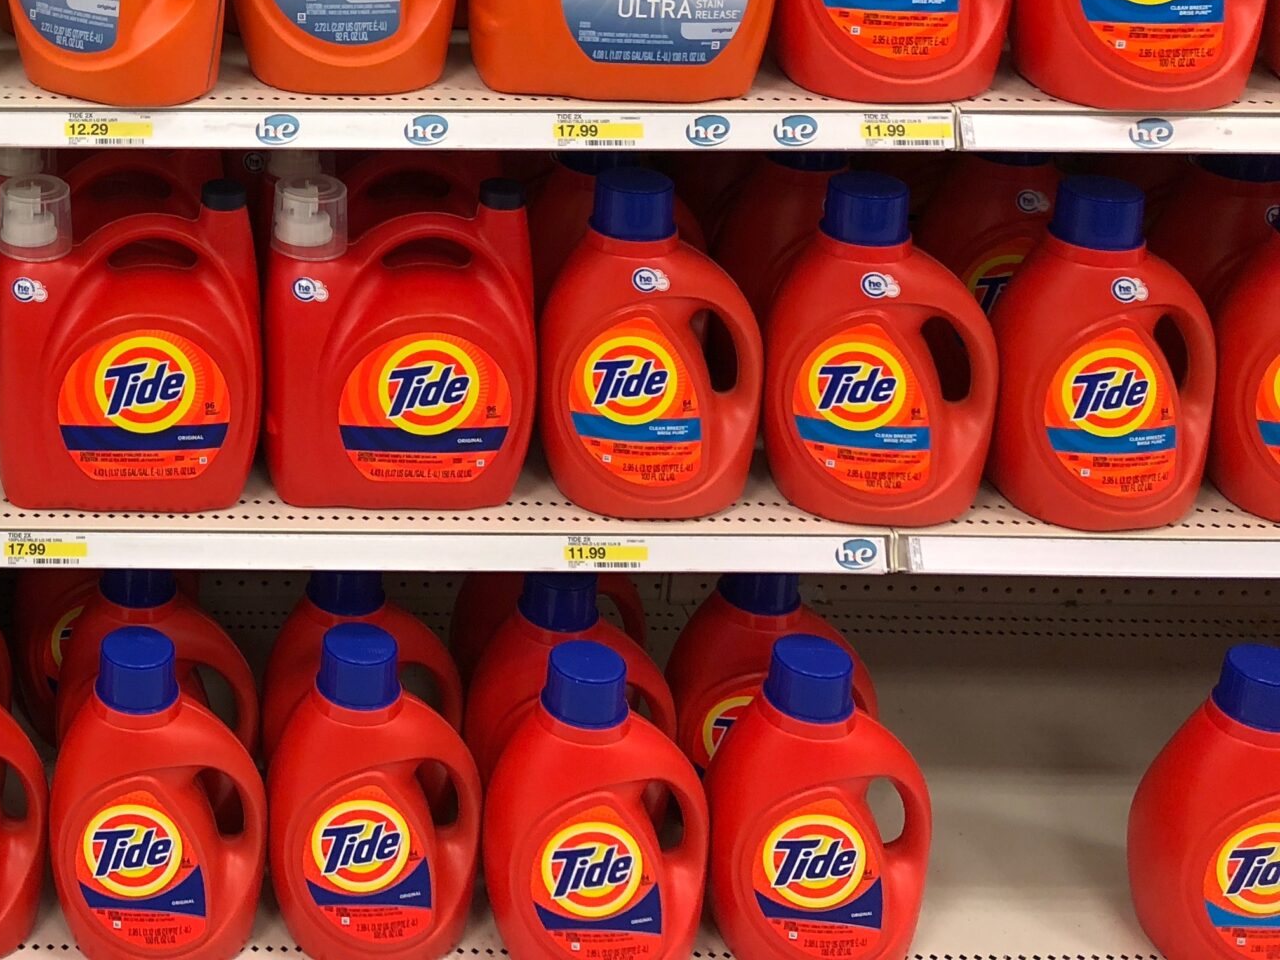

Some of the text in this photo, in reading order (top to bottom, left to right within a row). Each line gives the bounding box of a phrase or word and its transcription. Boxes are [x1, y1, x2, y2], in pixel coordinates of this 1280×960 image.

[618, 0, 691, 18] ULTRA
[696, 0, 723, 8] STAIN
[69, 124, 108, 135] 12.29
[258, 117, 298, 143] he
[406, 117, 446, 143] he
[558, 125, 597, 136] 17.99
[688, 118, 728, 144] he
[776, 117, 815, 143] he
[865, 125, 905, 136] 11.99
[1131, 121, 1172, 147] he
[105, 362, 185, 418] Tide
[386, 364, 469, 419] Tide
[592, 360, 667, 406] Tide
[816, 365, 896, 411] Tide
[1071, 370, 1148, 421] Tide
[9, 544, 45, 555] 17.99
[569, 548, 606, 559] 11.99
[837, 542, 875, 568] he
[93, 828, 171, 879] Tide
[322, 822, 400, 875] Tide
[551, 846, 632, 899] Tide
[772, 838, 857, 888] Tide
